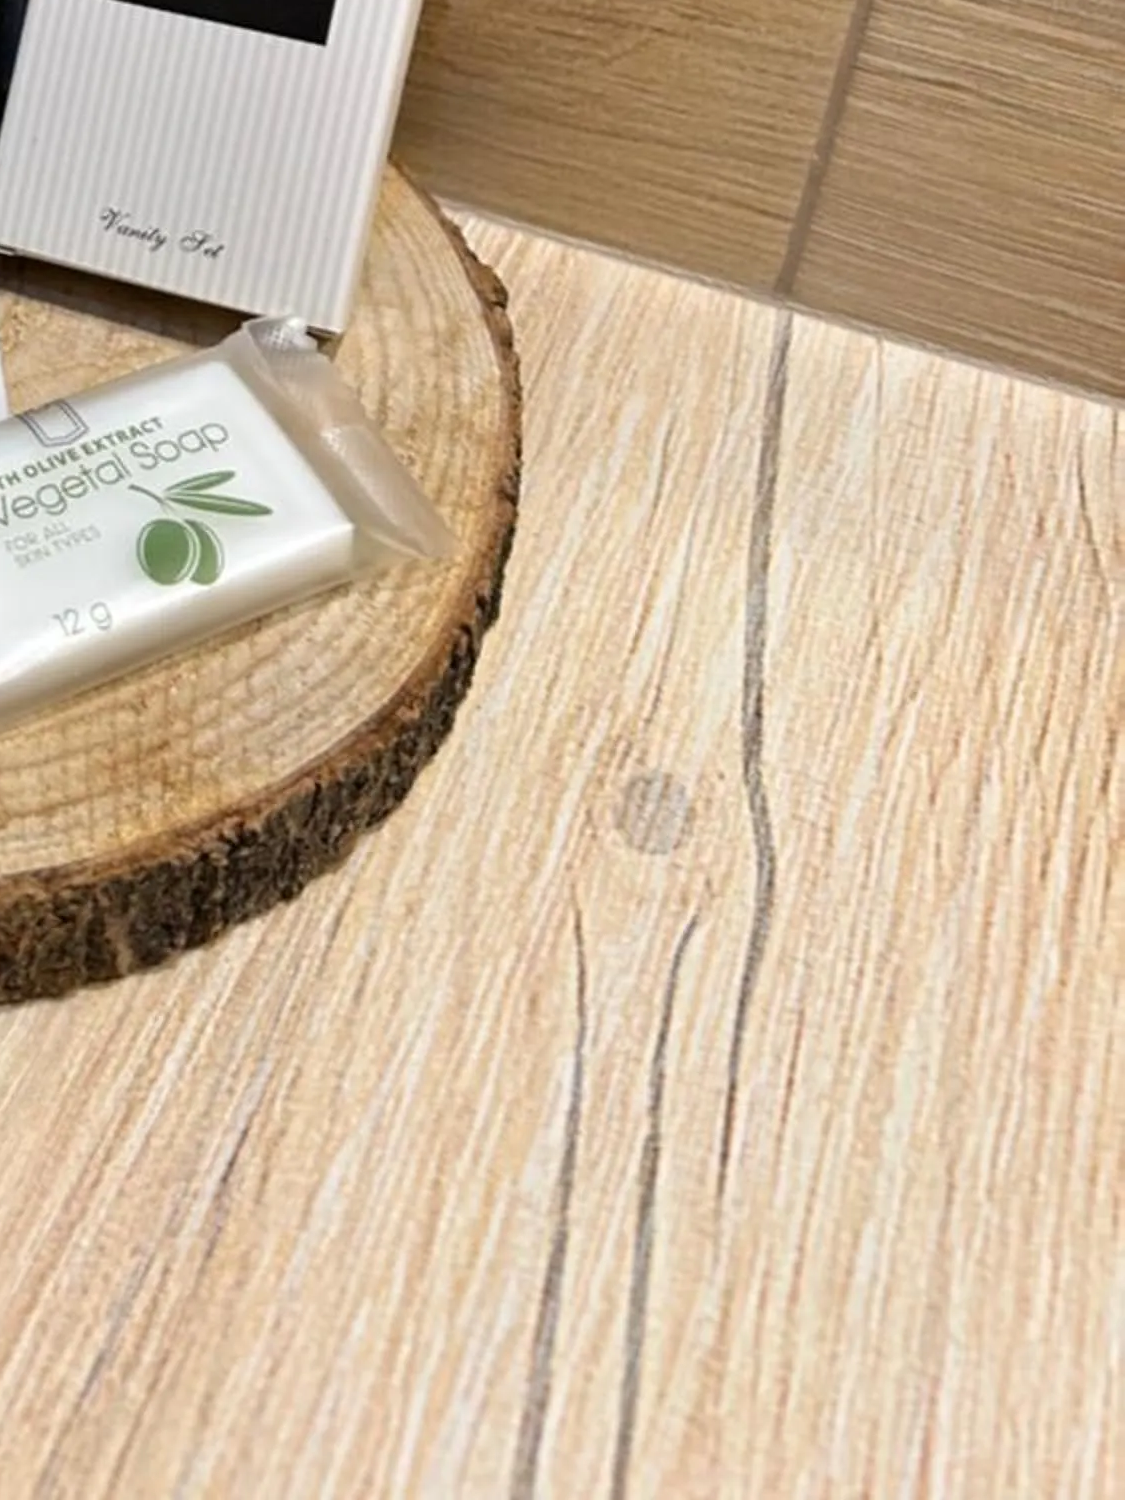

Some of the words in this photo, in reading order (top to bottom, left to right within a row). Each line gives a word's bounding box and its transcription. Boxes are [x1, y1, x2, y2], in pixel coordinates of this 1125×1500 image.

[99, 207, 169, 253] Vanity
[178, 229, 225, 260] Set
[22, 446, 81, 480] OLIVE
[81, 416, 164, 458] EXTRACT
[127, 422, 230, 471] Soap
[51, 607, 86, 637] 12
[88, 601, 113, 631] g
